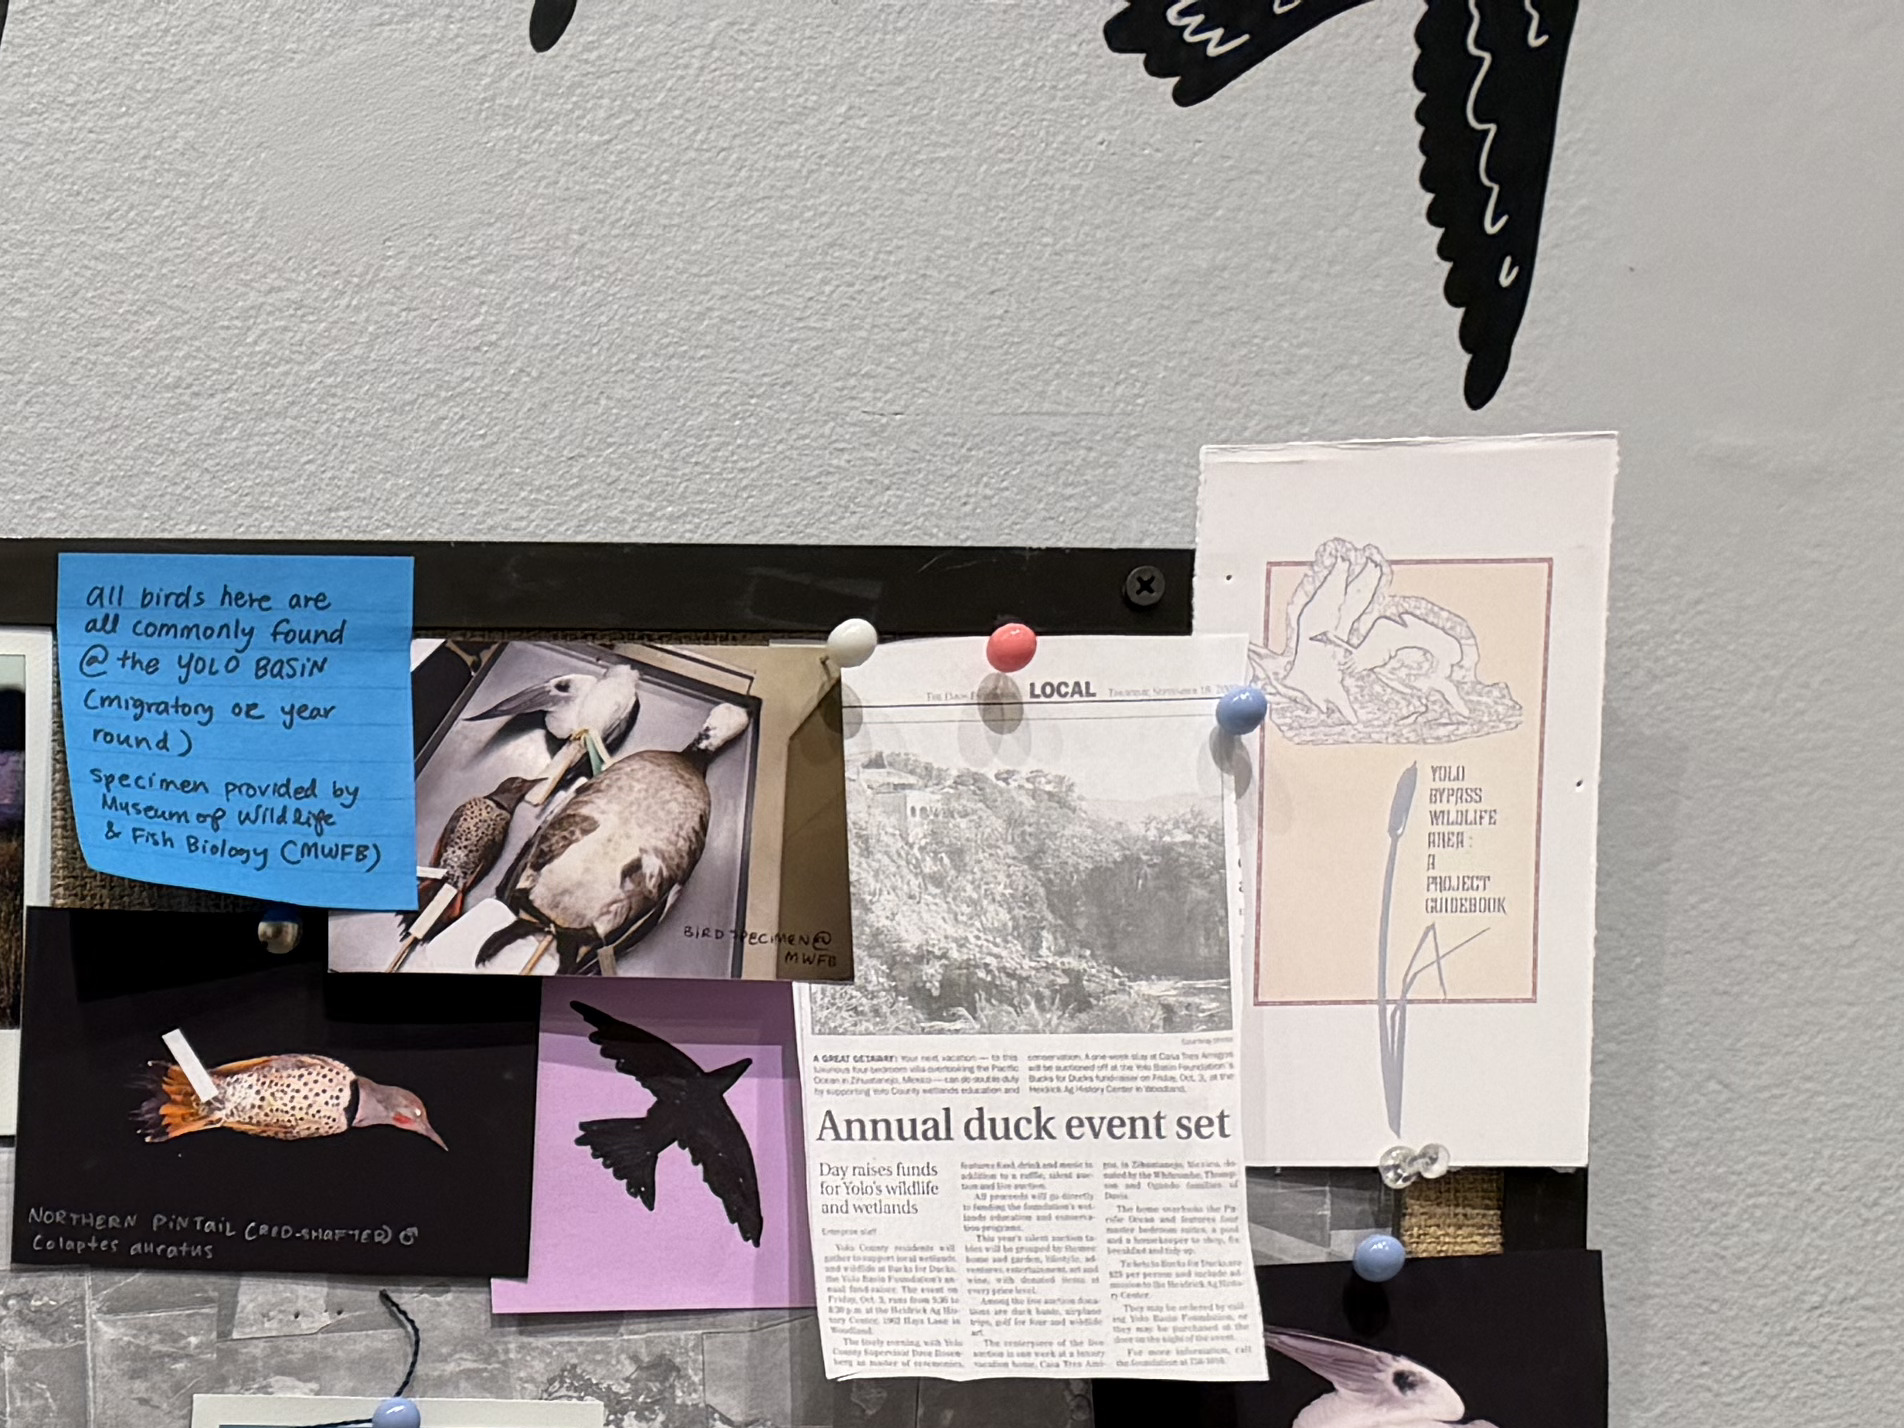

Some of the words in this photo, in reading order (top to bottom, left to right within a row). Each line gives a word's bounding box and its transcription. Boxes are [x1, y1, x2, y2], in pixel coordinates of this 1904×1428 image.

[1030, 681, 1096, 698] LOCAL
[816, 1107, 954, 1141] Annual
[964, 1106, 1056, 1140] duck
[1066, 1111, 1166, 1140] event
[1176, 1110, 1230, 1139] set
[820, 1163, 848, 1180] Day
[897, 1162, 938, 1176] funds
[821, 1181, 840, 1195] for
[843, 1181, 891, 1195] Yolo's
[887, 1181, 938, 1195] wildlife
[822, 1199, 848, 1214] and
[853, 1199, 918, 1214] wetlands
